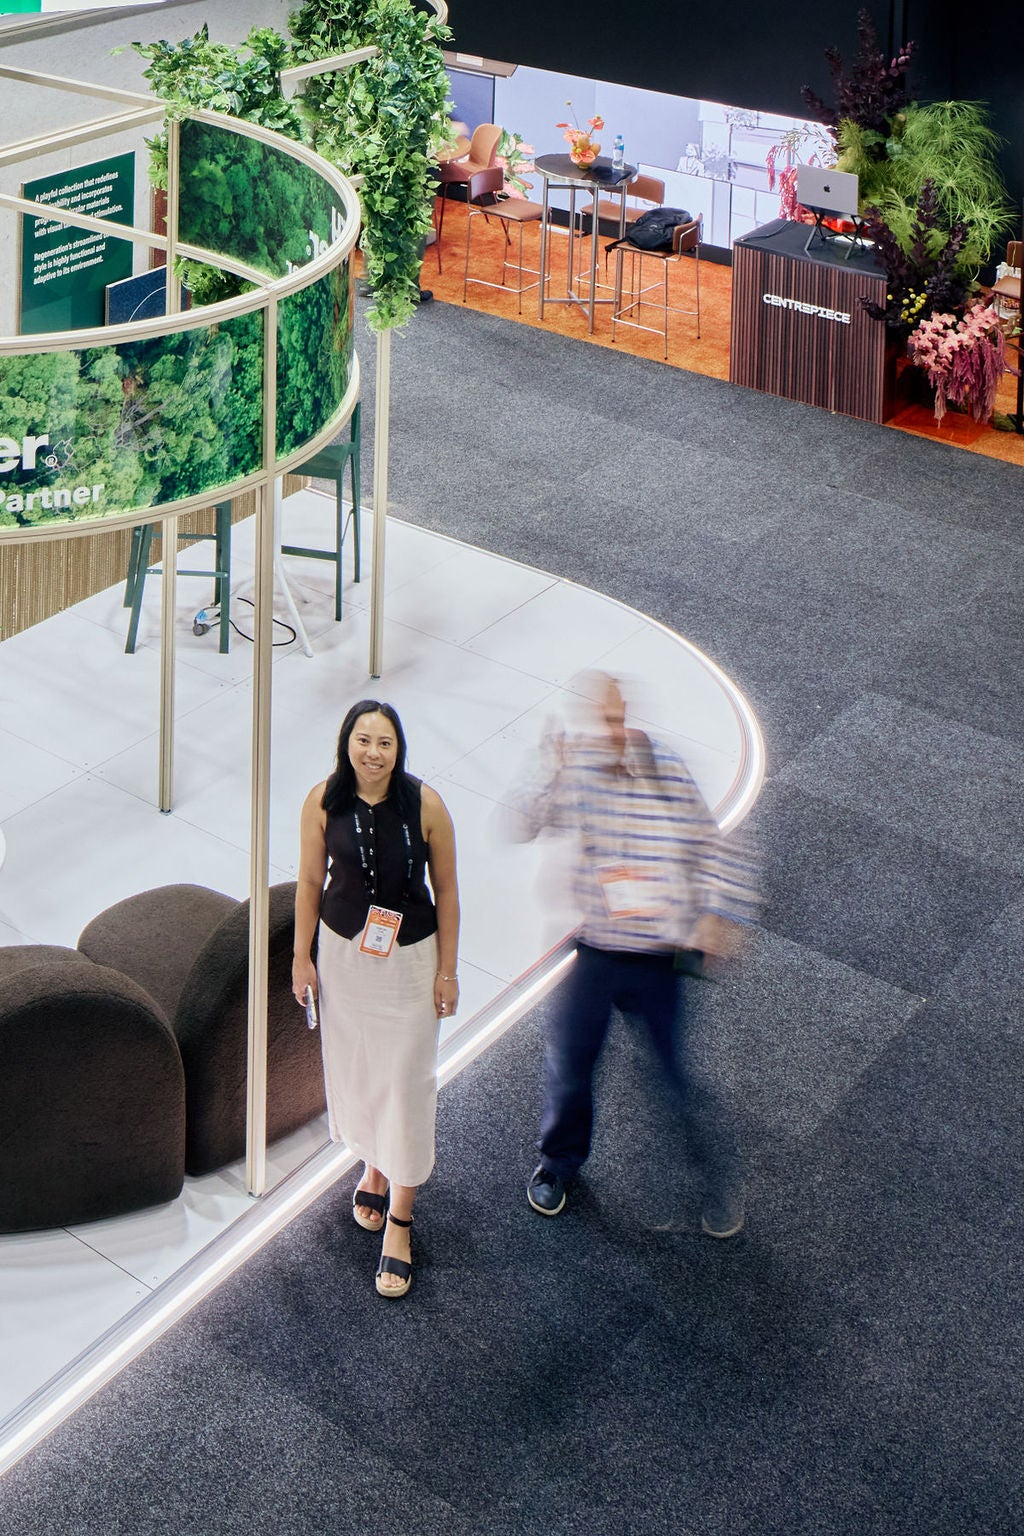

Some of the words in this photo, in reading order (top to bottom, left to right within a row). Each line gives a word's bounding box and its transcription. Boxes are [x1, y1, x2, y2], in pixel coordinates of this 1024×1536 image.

[39, 188, 58, 204] playful
[58, 182, 84, 196] collection
[84, 178, 95, 188] that
[95, 171, 119, 185] redefines
[70, 193, 81, 204] and
[81, 185, 113, 200] incorporates
[86, 196, 110, 210] materials
[34, 227, 47, 239] with
[47, 221, 63, 234] visual
[33, 242, 73, 262] Regeneration's
[72, 233, 103, 249] streamlined
[34, 262, 47, 274] style
[47, 260, 53, 269] is
[53, 255, 70, 267] highly
[69, 245, 96, 261] functional
[95, 241, 106, 253] and
[33, 272, 57, 285] adaptive
[56, 269, 63, 277] to
[62, 266, 70, 275] its
[70, 255, 104, 273] environment.
[762, 292, 851, 325] CENTREPIECE
